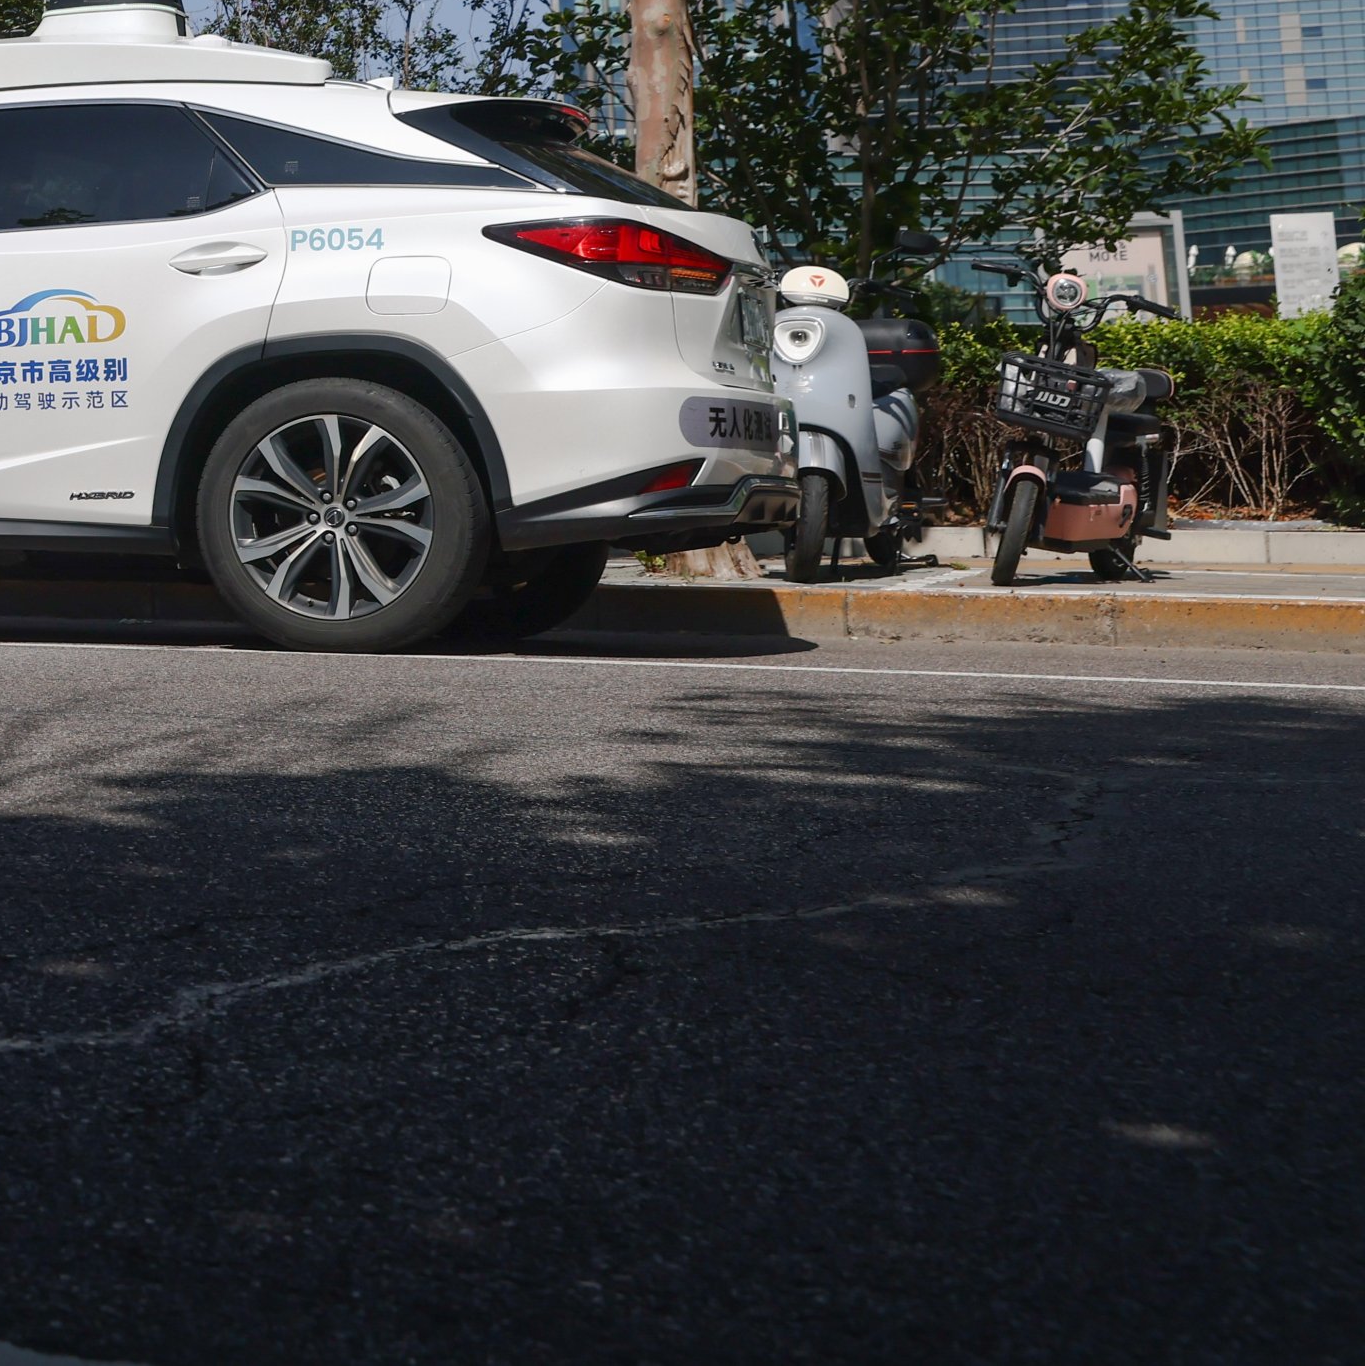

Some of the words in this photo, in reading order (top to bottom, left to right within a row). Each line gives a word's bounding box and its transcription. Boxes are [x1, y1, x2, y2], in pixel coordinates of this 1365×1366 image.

[290, 227, 385, 252] P6054
[1089, 250, 1128, 262] MOE
[69, 491, 135, 501] HYBRID
